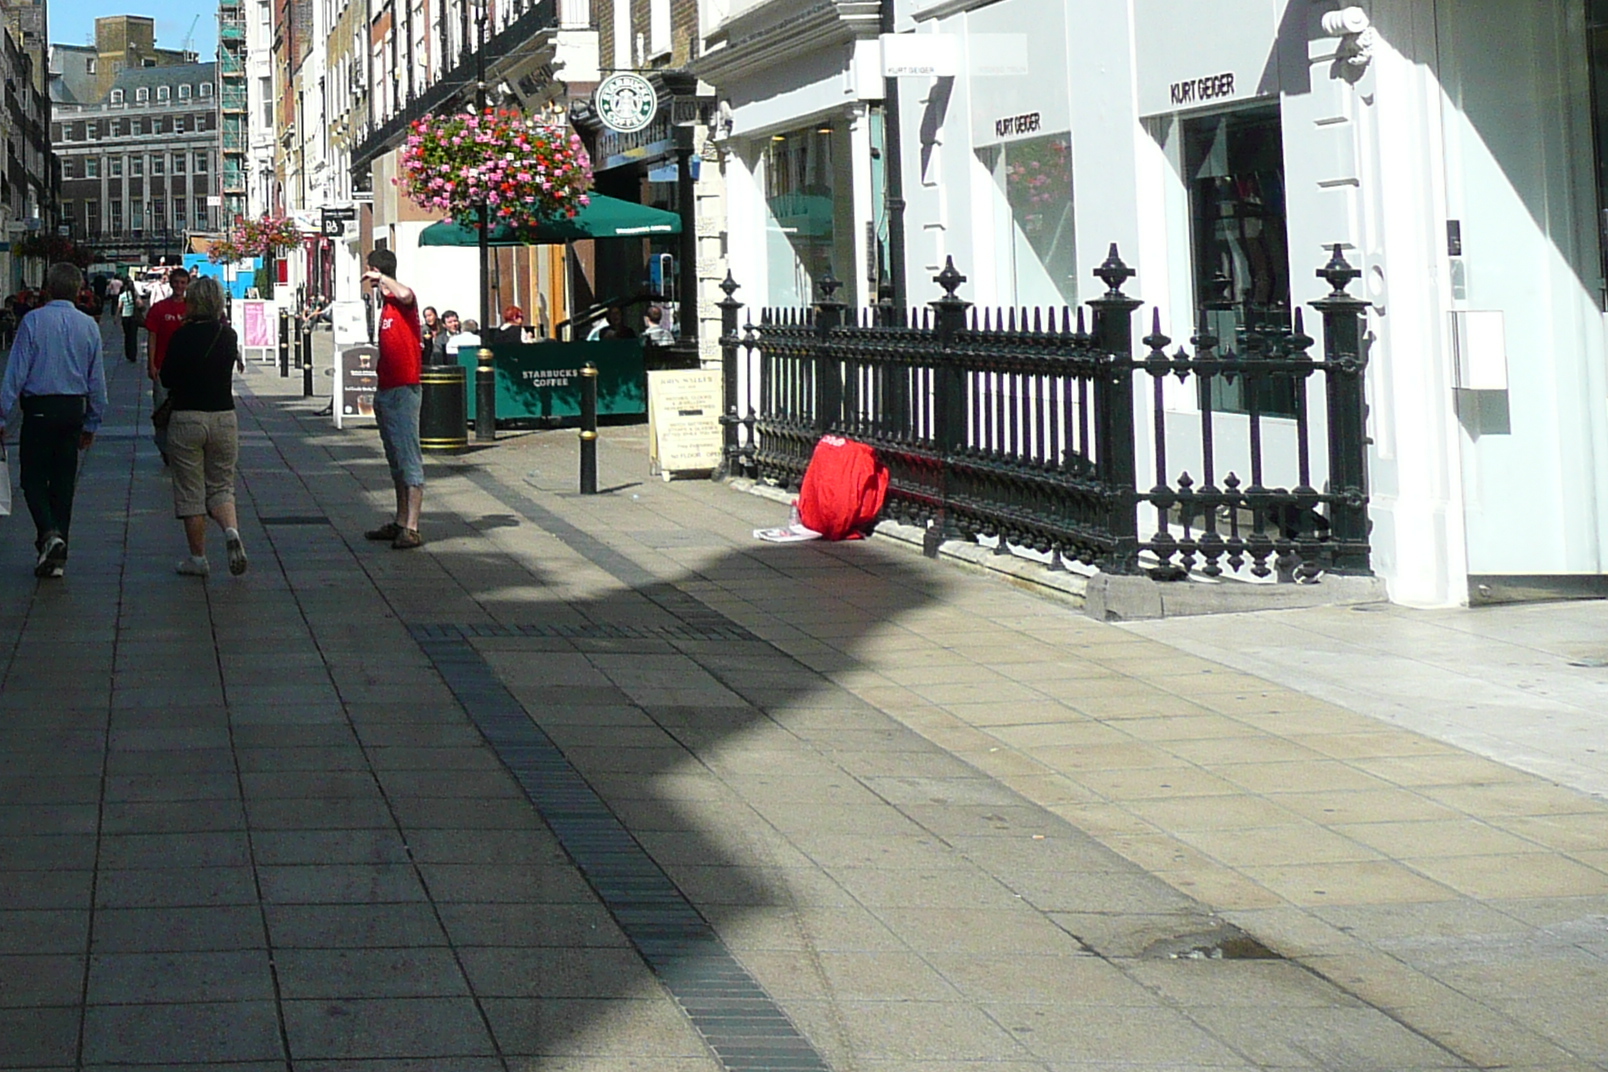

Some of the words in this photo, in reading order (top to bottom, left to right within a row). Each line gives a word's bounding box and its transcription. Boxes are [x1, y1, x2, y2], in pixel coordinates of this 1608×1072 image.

[1170, 79, 1196, 105] KURT
[1198, 73, 1235, 101] GEIGER
[995, 116, 1013, 137] KURT
[1014, 112, 1041, 134] GEIGER
[522, 369, 578, 380] STARBUCKS
[533, 378, 569, 387] COFFEE
